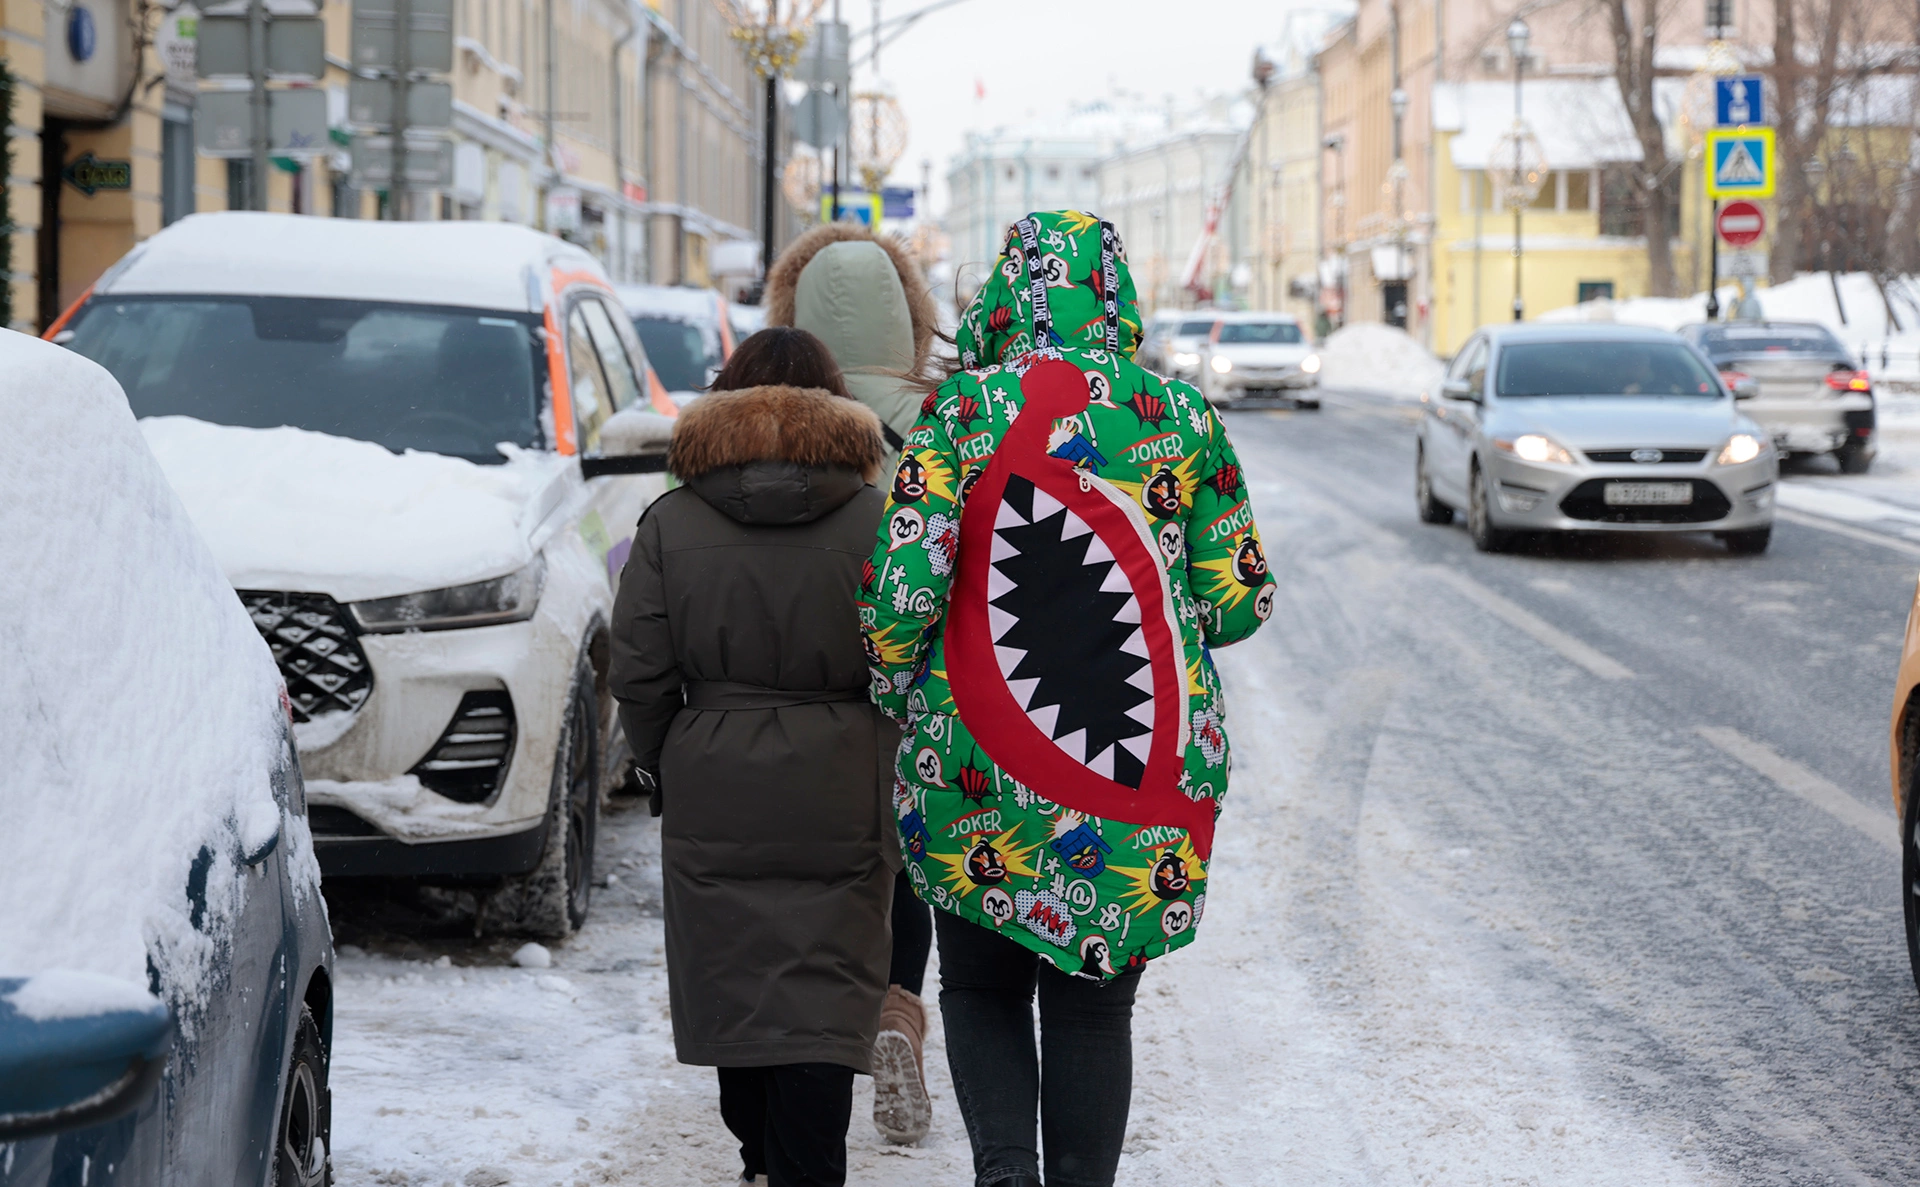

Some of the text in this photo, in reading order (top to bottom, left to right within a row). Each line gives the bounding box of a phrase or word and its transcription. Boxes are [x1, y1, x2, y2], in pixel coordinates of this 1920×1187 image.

[1128, 434, 1184, 463] JOKER
[1209, 500, 1254, 542] JOKER
[948, 809, 1003, 838] JOKER
